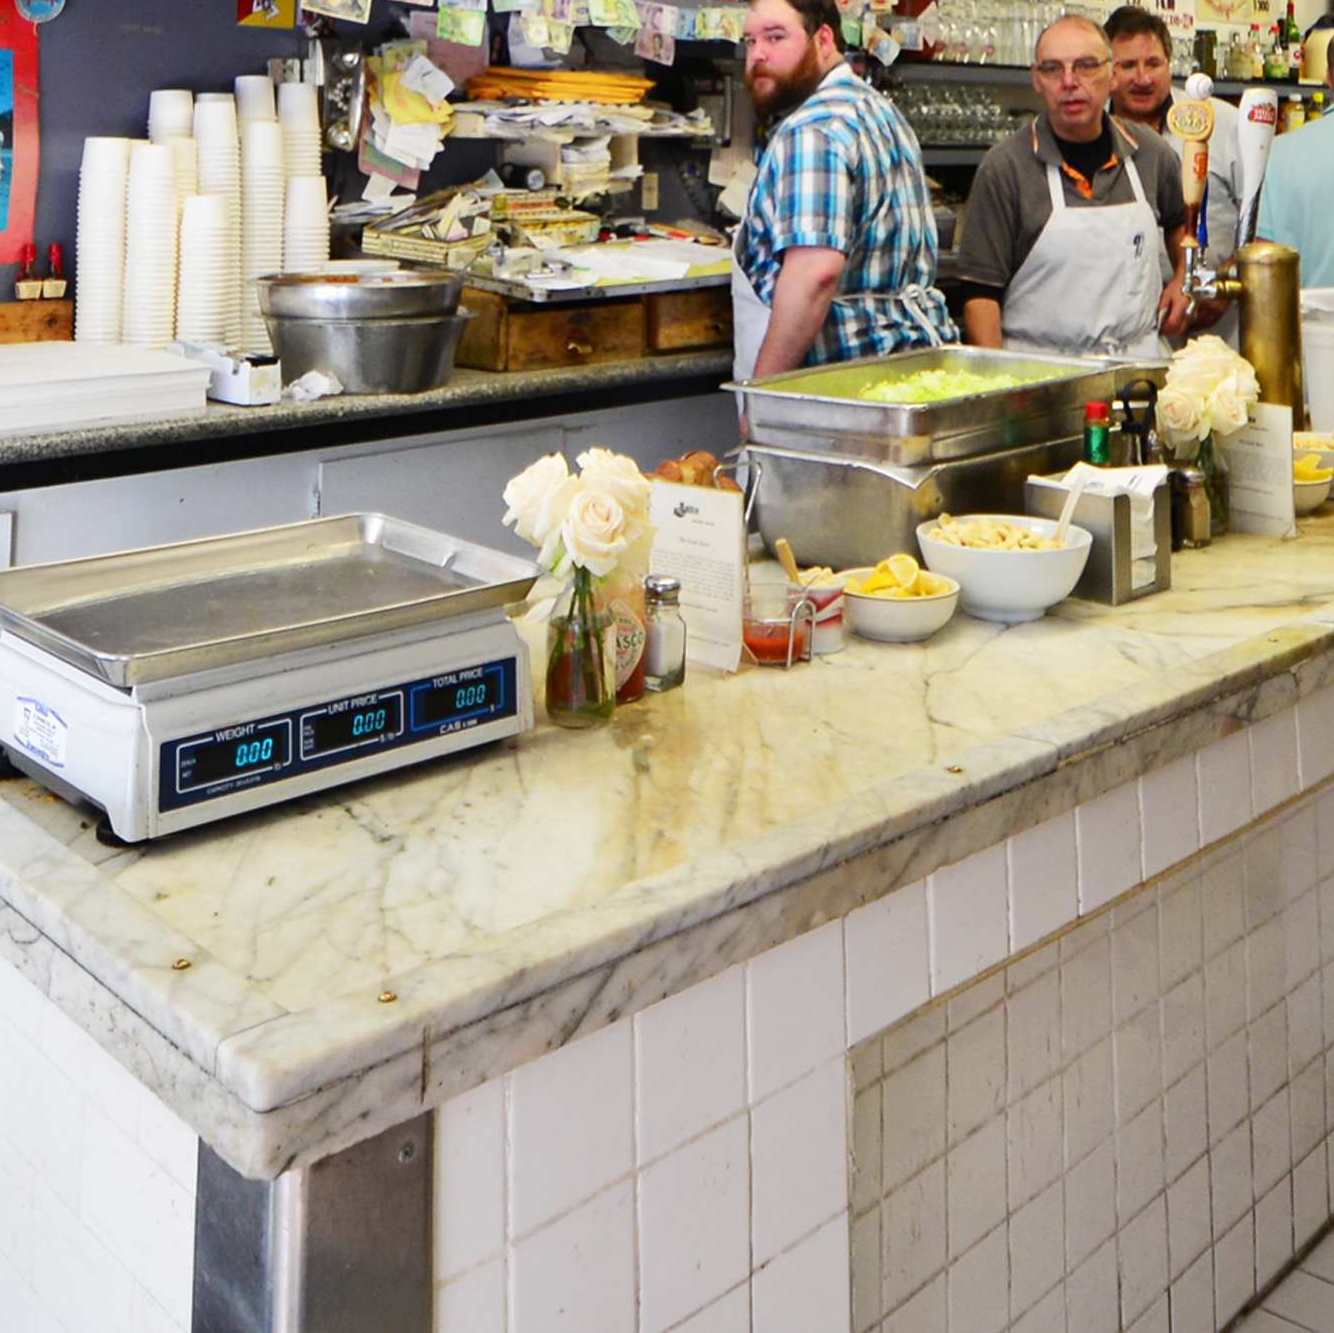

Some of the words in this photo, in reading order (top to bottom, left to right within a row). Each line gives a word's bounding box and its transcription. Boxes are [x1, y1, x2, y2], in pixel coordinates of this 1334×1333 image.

[615, 630, 644, 651] ASCO
[432, 674, 459, 689] TOTAL
[458, 666, 484, 683] PRICE
[327, 702, 350, 715] UNIT
[350, 692, 379, 710] PRICE
[454, 683, 487, 710] 0.00
[215, 723, 256, 743] WEIGHT
[352, 709, 387, 736] 0.00
[438, 719, 462, 735] CAS
[234, 736, 274, 768] 0.00
